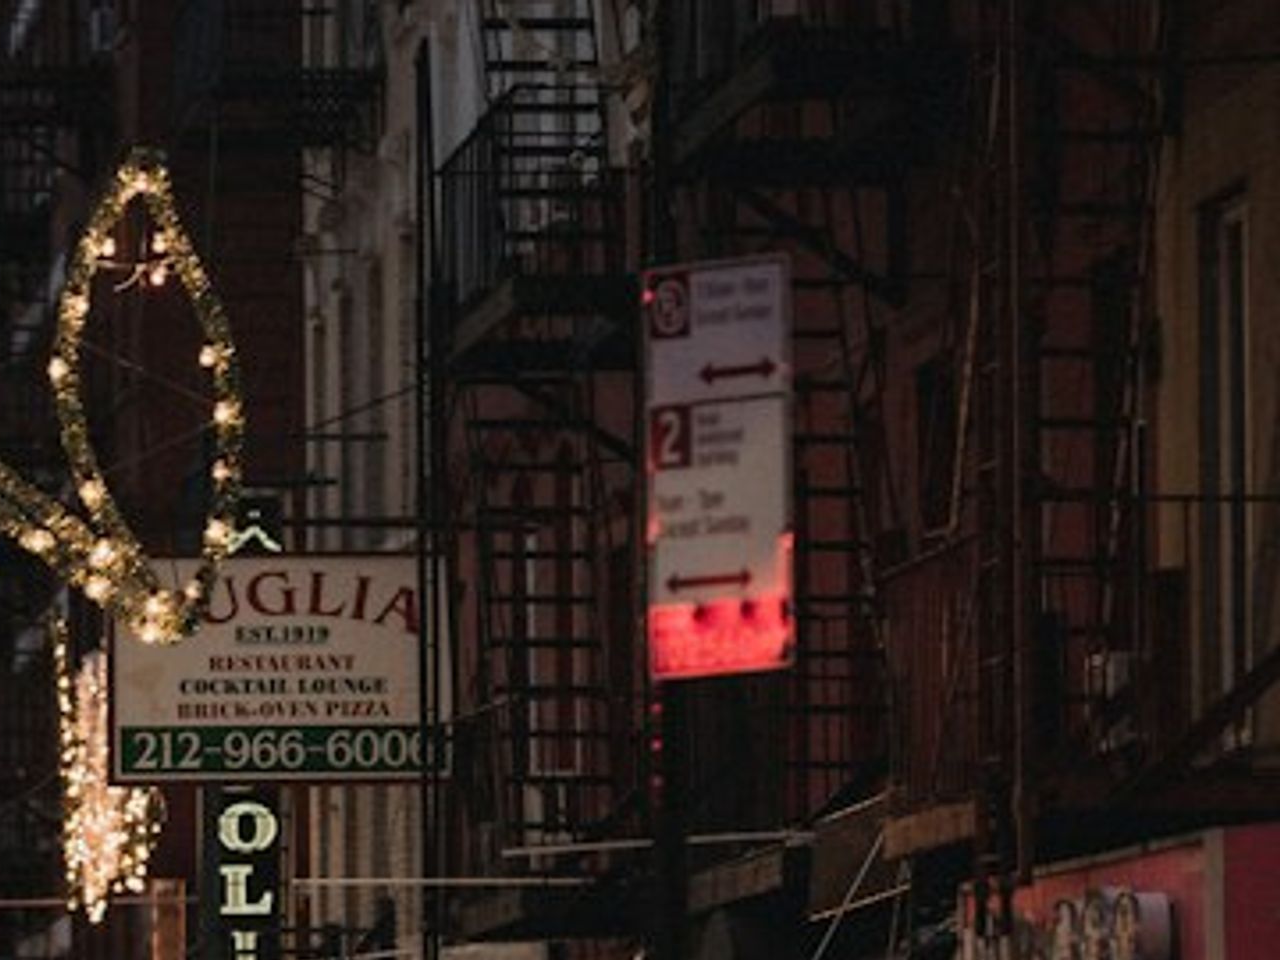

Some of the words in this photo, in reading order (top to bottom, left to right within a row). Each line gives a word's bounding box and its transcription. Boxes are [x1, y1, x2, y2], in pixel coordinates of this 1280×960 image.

[659, 411, 683, 464] 2
[196, 570, 419, 635] UGLIA
[208, 655, 356, 673] RESTAURANT
[179, 678, 288, 696] COCKTAIL
[298, 677, 389, 696] LOUNGE
[177, 702, 320, 720] BRICK-OVEN
[326, 701, 391, 719] PIZZA
